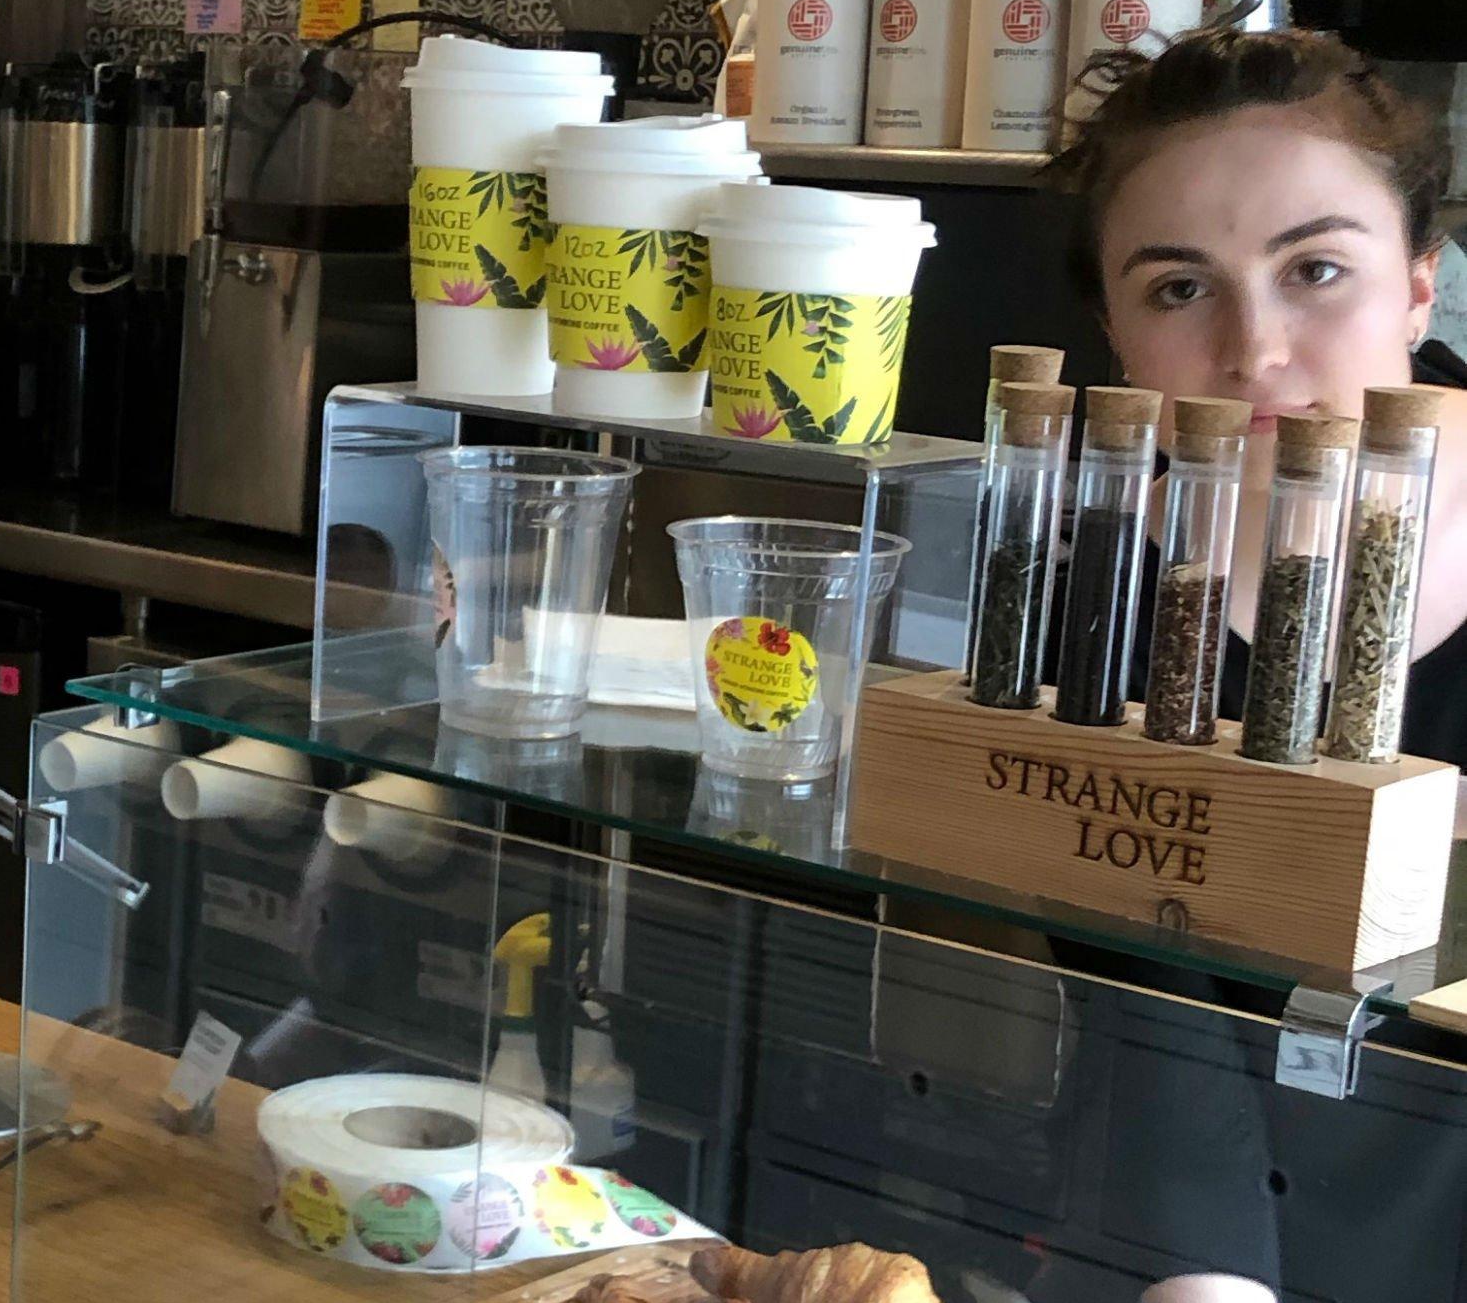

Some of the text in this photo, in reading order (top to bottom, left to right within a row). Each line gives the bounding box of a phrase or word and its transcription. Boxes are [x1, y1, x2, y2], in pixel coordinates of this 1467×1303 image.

[412, 206, 472, 231] RANGE
[419, 232, 472, 254] LOVE
[546, 262, 622, 291] RANGE
[560, 290, 621, 315] LOVE
[713, 356, 762, 380] LOVE
[723, 650, 792, 675] STRANGE
[749, 671, 791, 688] LOVE
[986, 749, 1212, 835] STRANGE
[1073, 817, 1206, 886] LOVE
